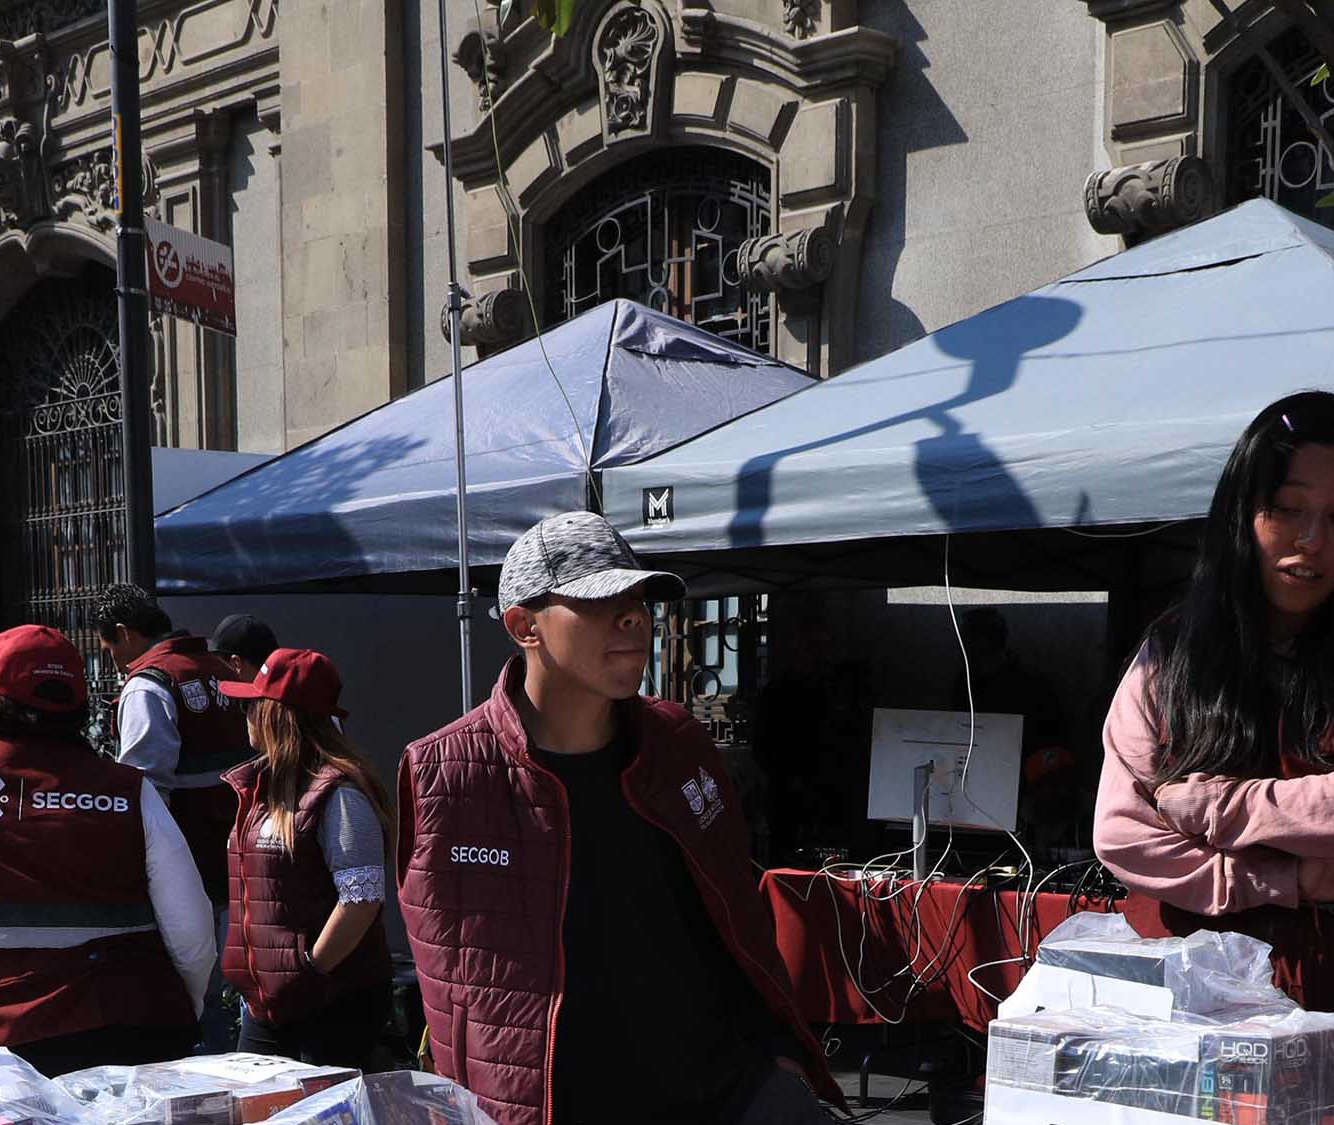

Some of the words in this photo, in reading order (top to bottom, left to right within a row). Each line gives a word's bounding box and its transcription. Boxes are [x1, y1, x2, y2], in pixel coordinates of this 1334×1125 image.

[32, 792, 129, 812] SECGOB
[450, 846, 509, 866] SECGOB
[1220, 1041, 1268, 1059] HQD
